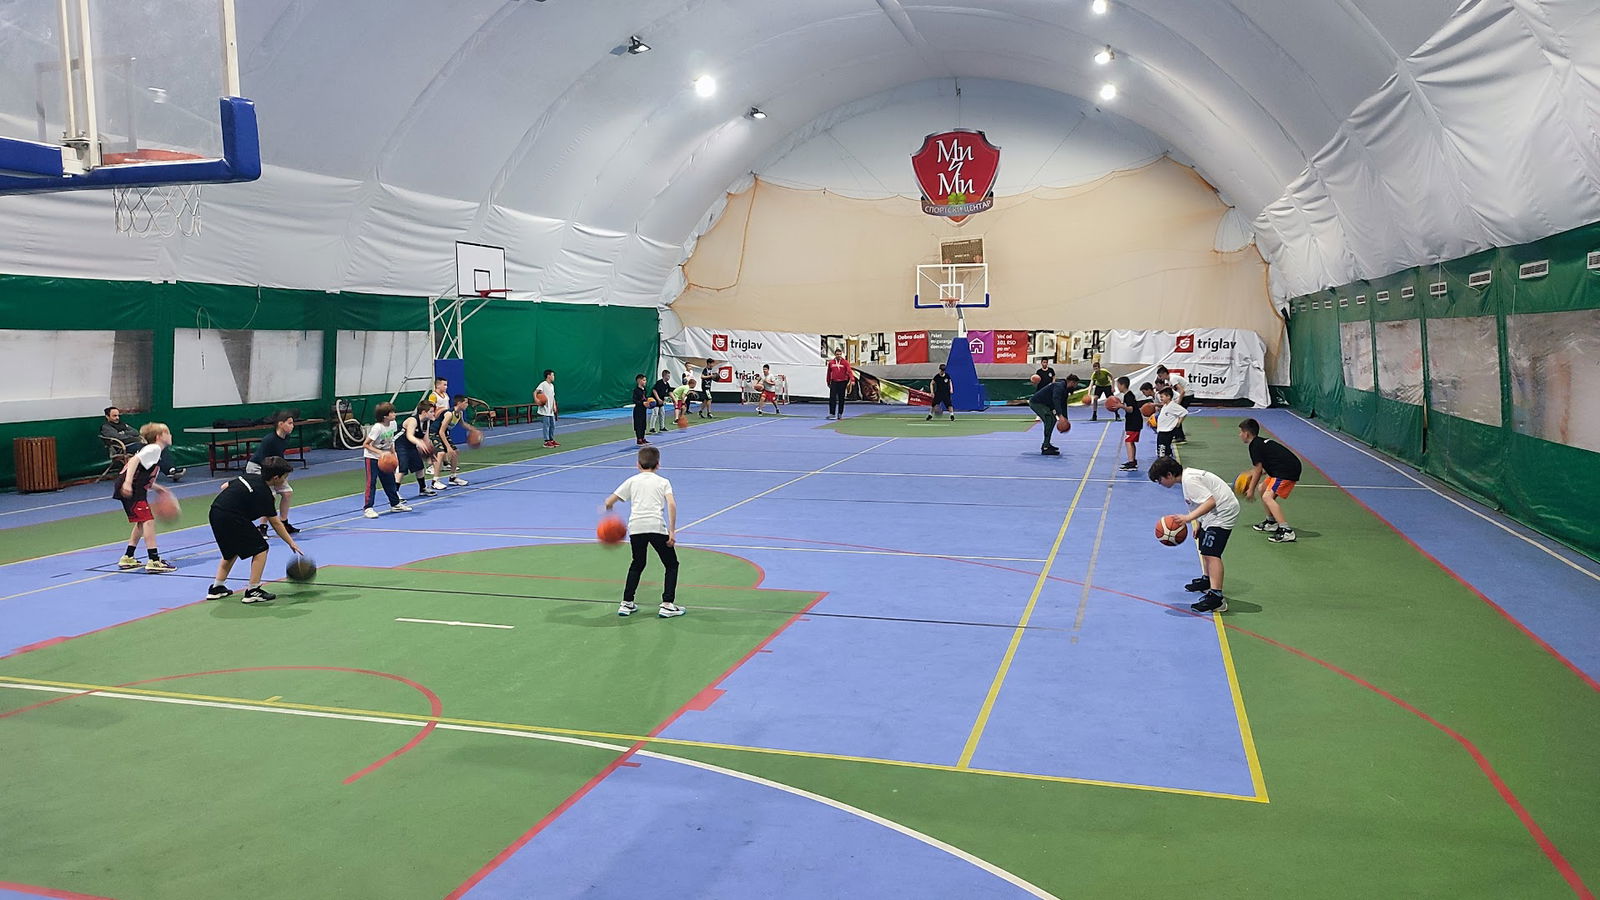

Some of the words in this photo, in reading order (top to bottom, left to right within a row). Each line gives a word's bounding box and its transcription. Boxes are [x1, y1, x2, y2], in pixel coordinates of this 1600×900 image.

[936, 139, 974, 163] Ми
[937, 172, 975, 196] Ми
[730, 339, 762, 352] triglav
[1197, 338, 1237, 352] triglav
[1188, 373, 1227, 387] triglav
